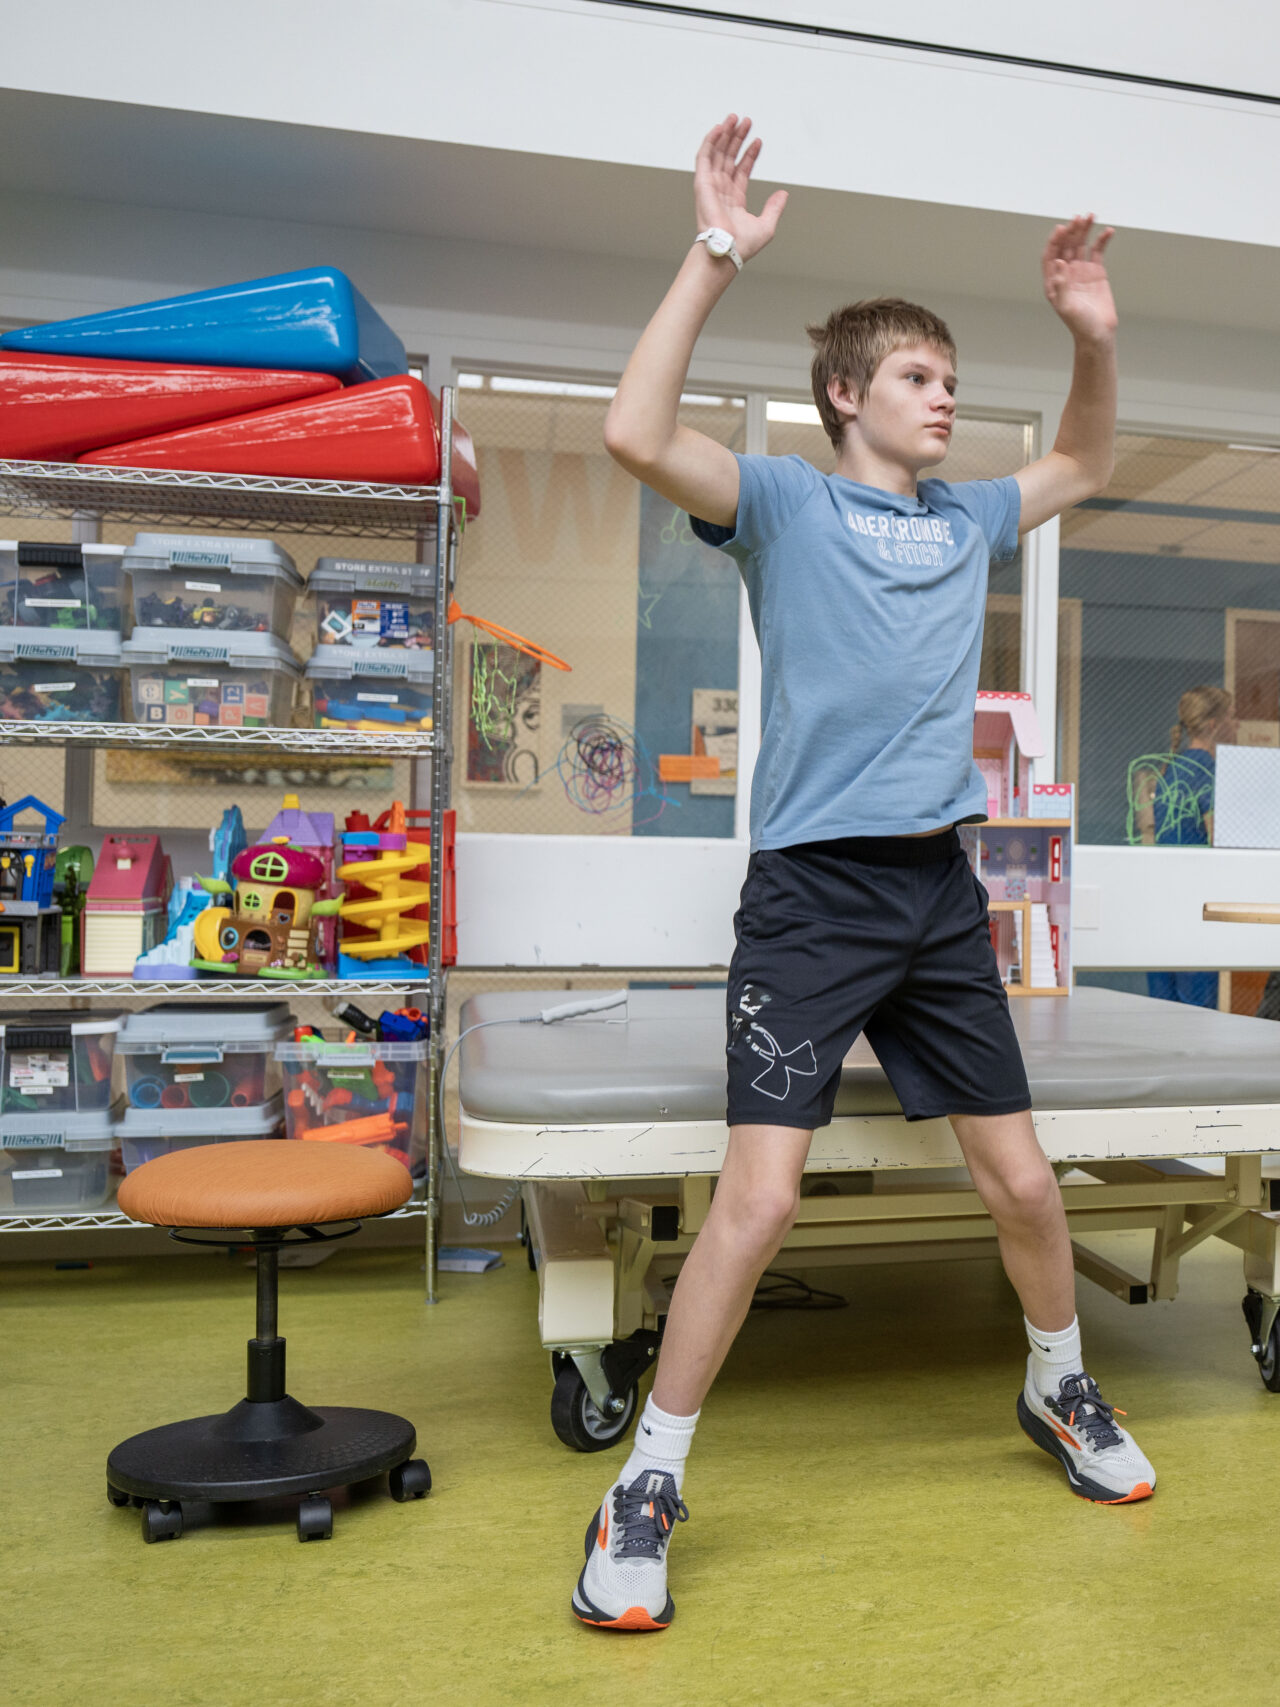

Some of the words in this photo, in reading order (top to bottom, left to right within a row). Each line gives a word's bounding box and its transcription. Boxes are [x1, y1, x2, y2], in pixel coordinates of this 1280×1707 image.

[848, 511, 955, 546] ABERCROMBE
[187, 552, 214, 564] Hefty
[878, 538, 893, 563] &
[894, 541, 944, 568] FITCH
[335, 562, 366, 573] STORE
[368, 564, 399, 575] EXTRA
[31, 645, 60, 657] Hefty
[186, 647, 212, 659] Hefty
[367, 662, 392, 673] Hefty
